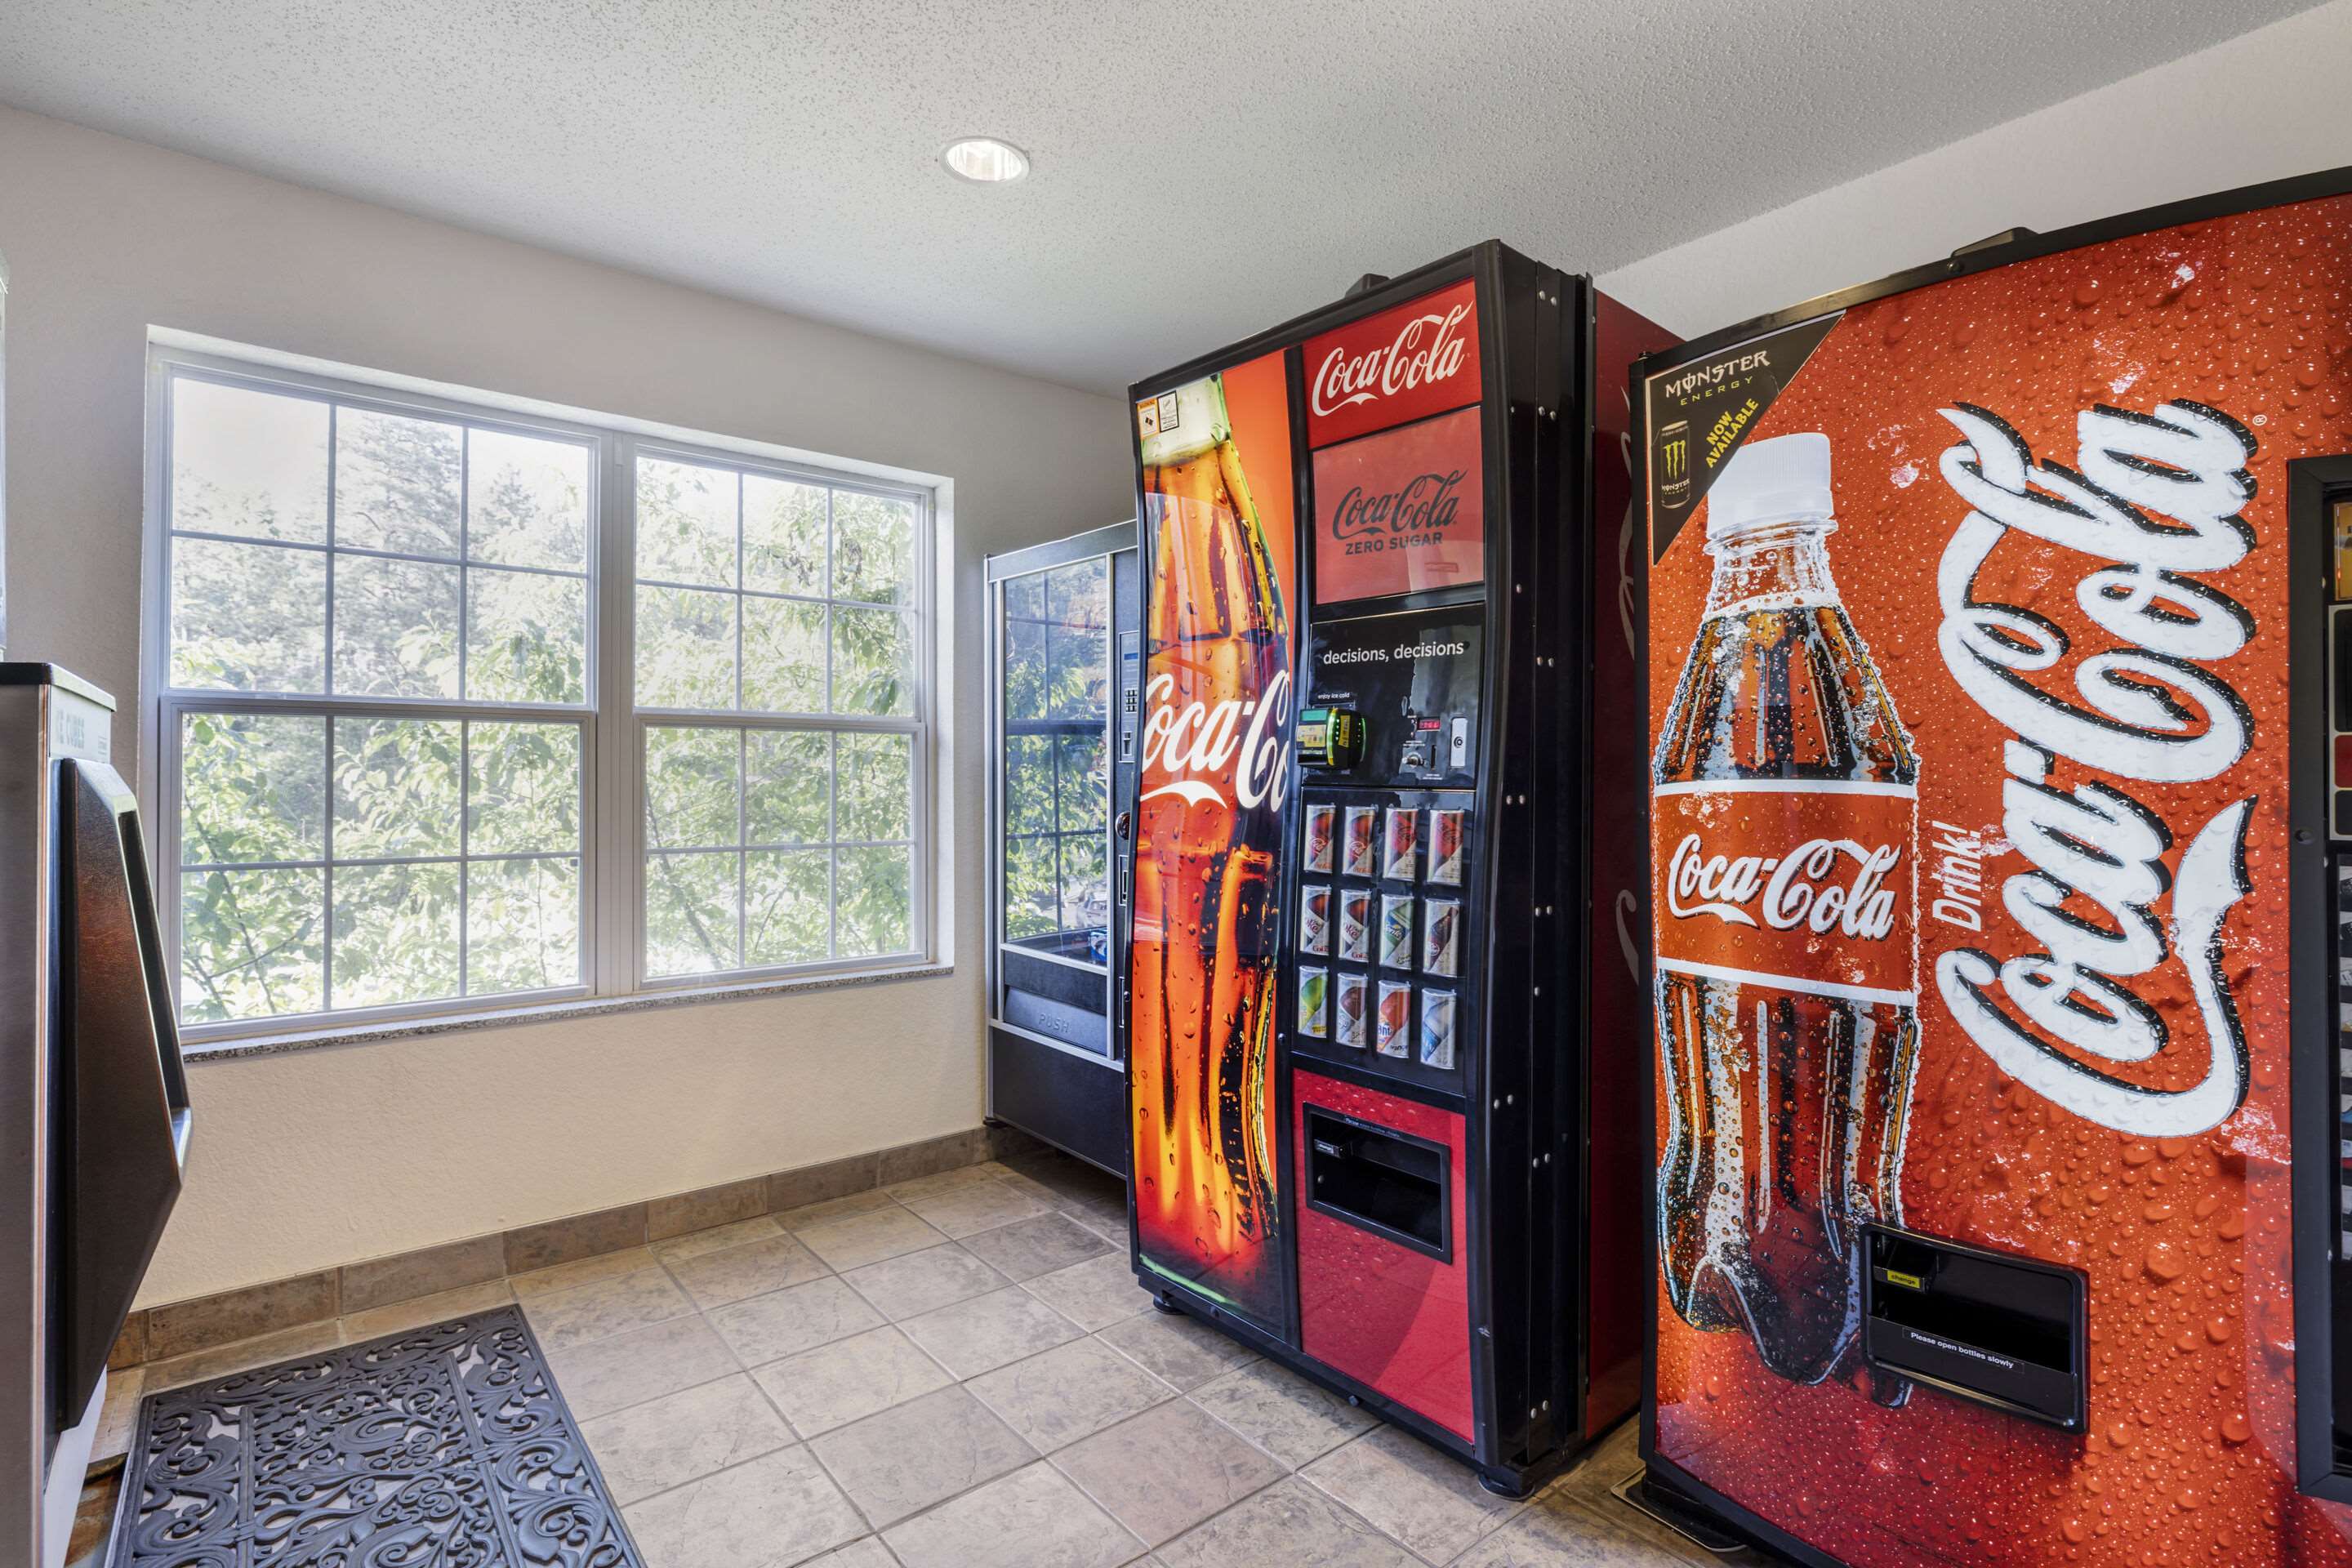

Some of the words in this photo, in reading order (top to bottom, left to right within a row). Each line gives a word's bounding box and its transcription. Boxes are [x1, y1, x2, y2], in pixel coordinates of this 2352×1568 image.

[1312, 300, 1474, 417] Coca-Cola
[1665, 350, 1771, 399] MONSTER
[1680, 376, 1753, 406] ENERGY
[1705, 398, 1759, 469] AVAILABLE
[1706, 411, 1733, 446] NOW
[1332, 469, 1468, 541] Coca-Cola
[1345, 540, 1384, 556] ZERO
[1389, 532, 1443, 550] SUGAR
[1323, 647, 1389, 666] decisions,
[1393, 640, 1464, 660] decisions
[1936, 398, 2258, 1138] Coca-Cola
[1667, 833, 1903, 941] Coca-Cola
[1931, 820, 1983, 933] Drink!
[1038, 1013, 1070, 1033] PUSH
[1910, 1331, 1936, 1345] Please
[1937, 1340, 1958, 1352] open
[1958, 1346, 1986, 1360] bottles
[1987, 1355, 2014, 1369] slowly
